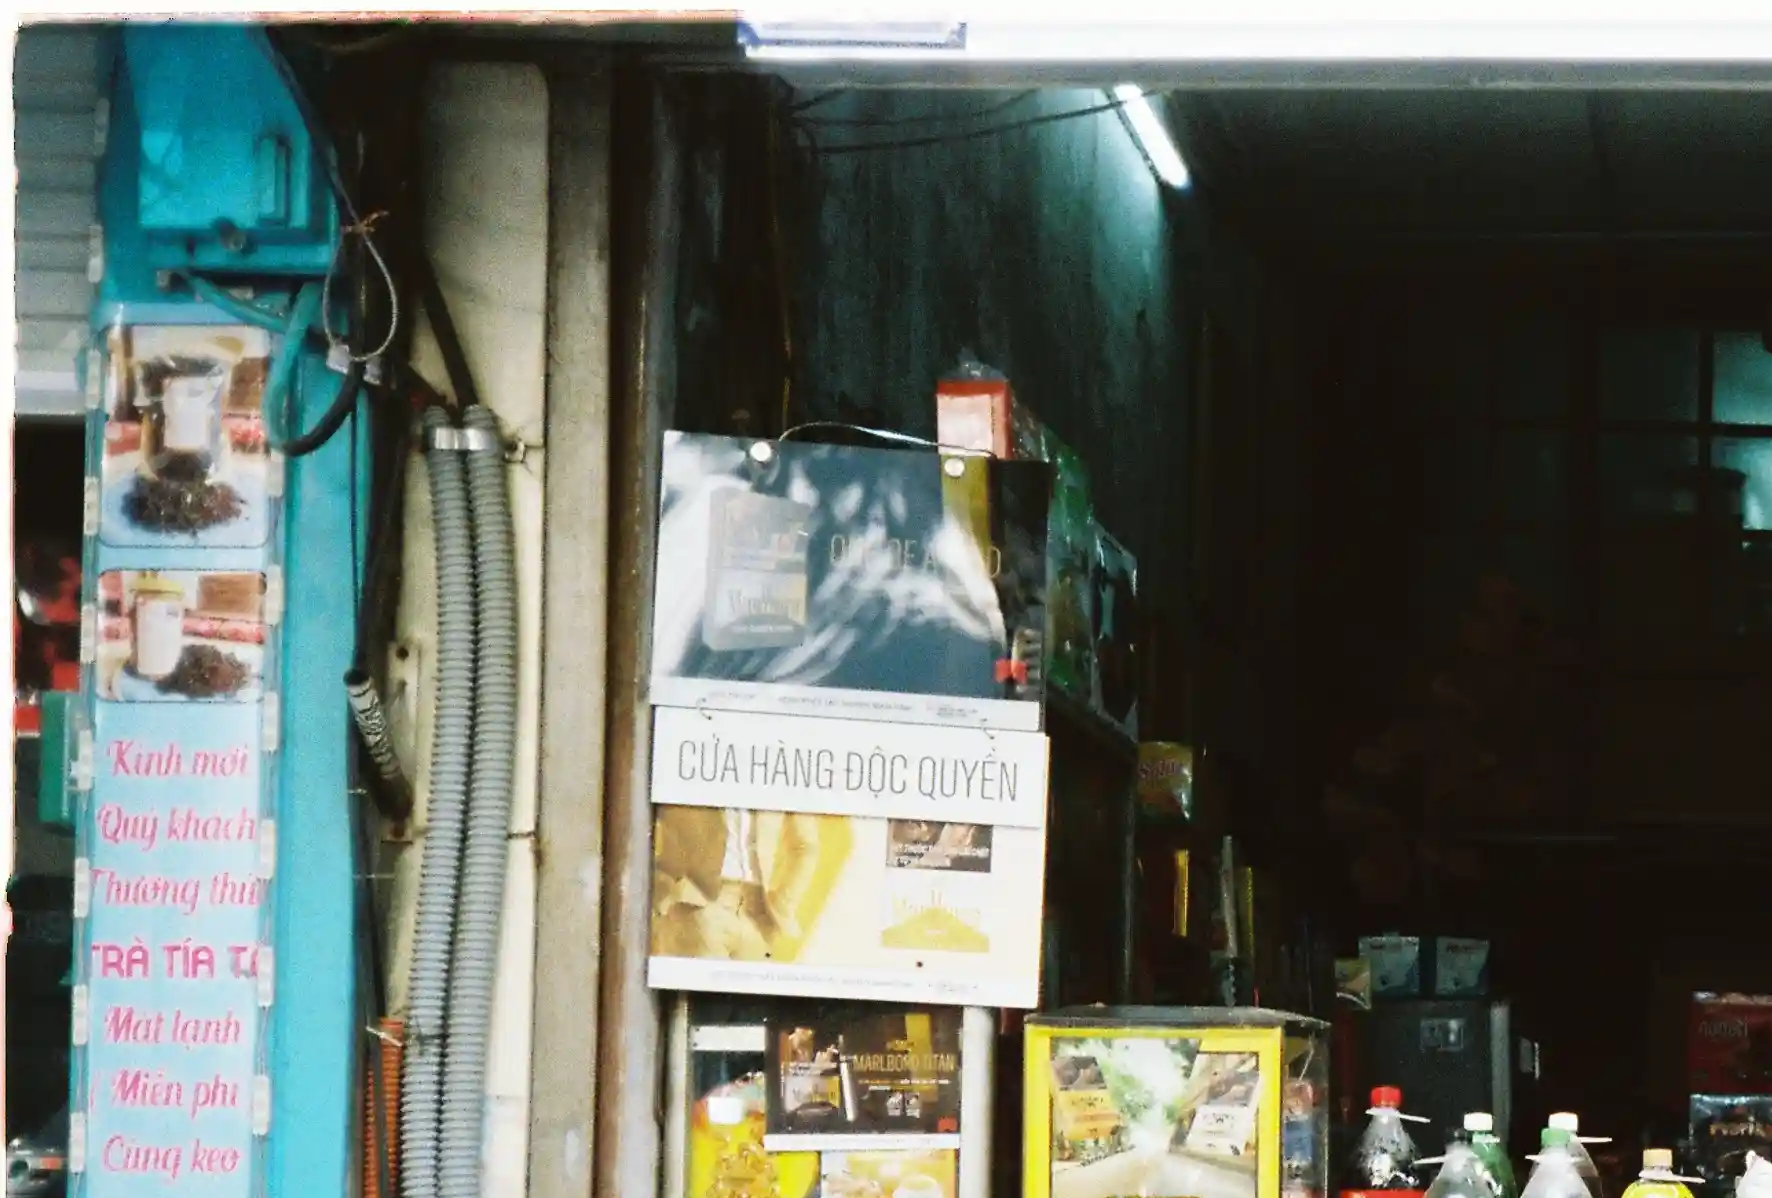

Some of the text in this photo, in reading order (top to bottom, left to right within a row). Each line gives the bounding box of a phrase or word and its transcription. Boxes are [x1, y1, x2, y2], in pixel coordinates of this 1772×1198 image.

[679, 733, 1018, 802] CỬA HÀNG ĐỘC QUYỀN
[162, 937, 215, 978] TÍA
[170, 1009, 241, 1050] lạnh
